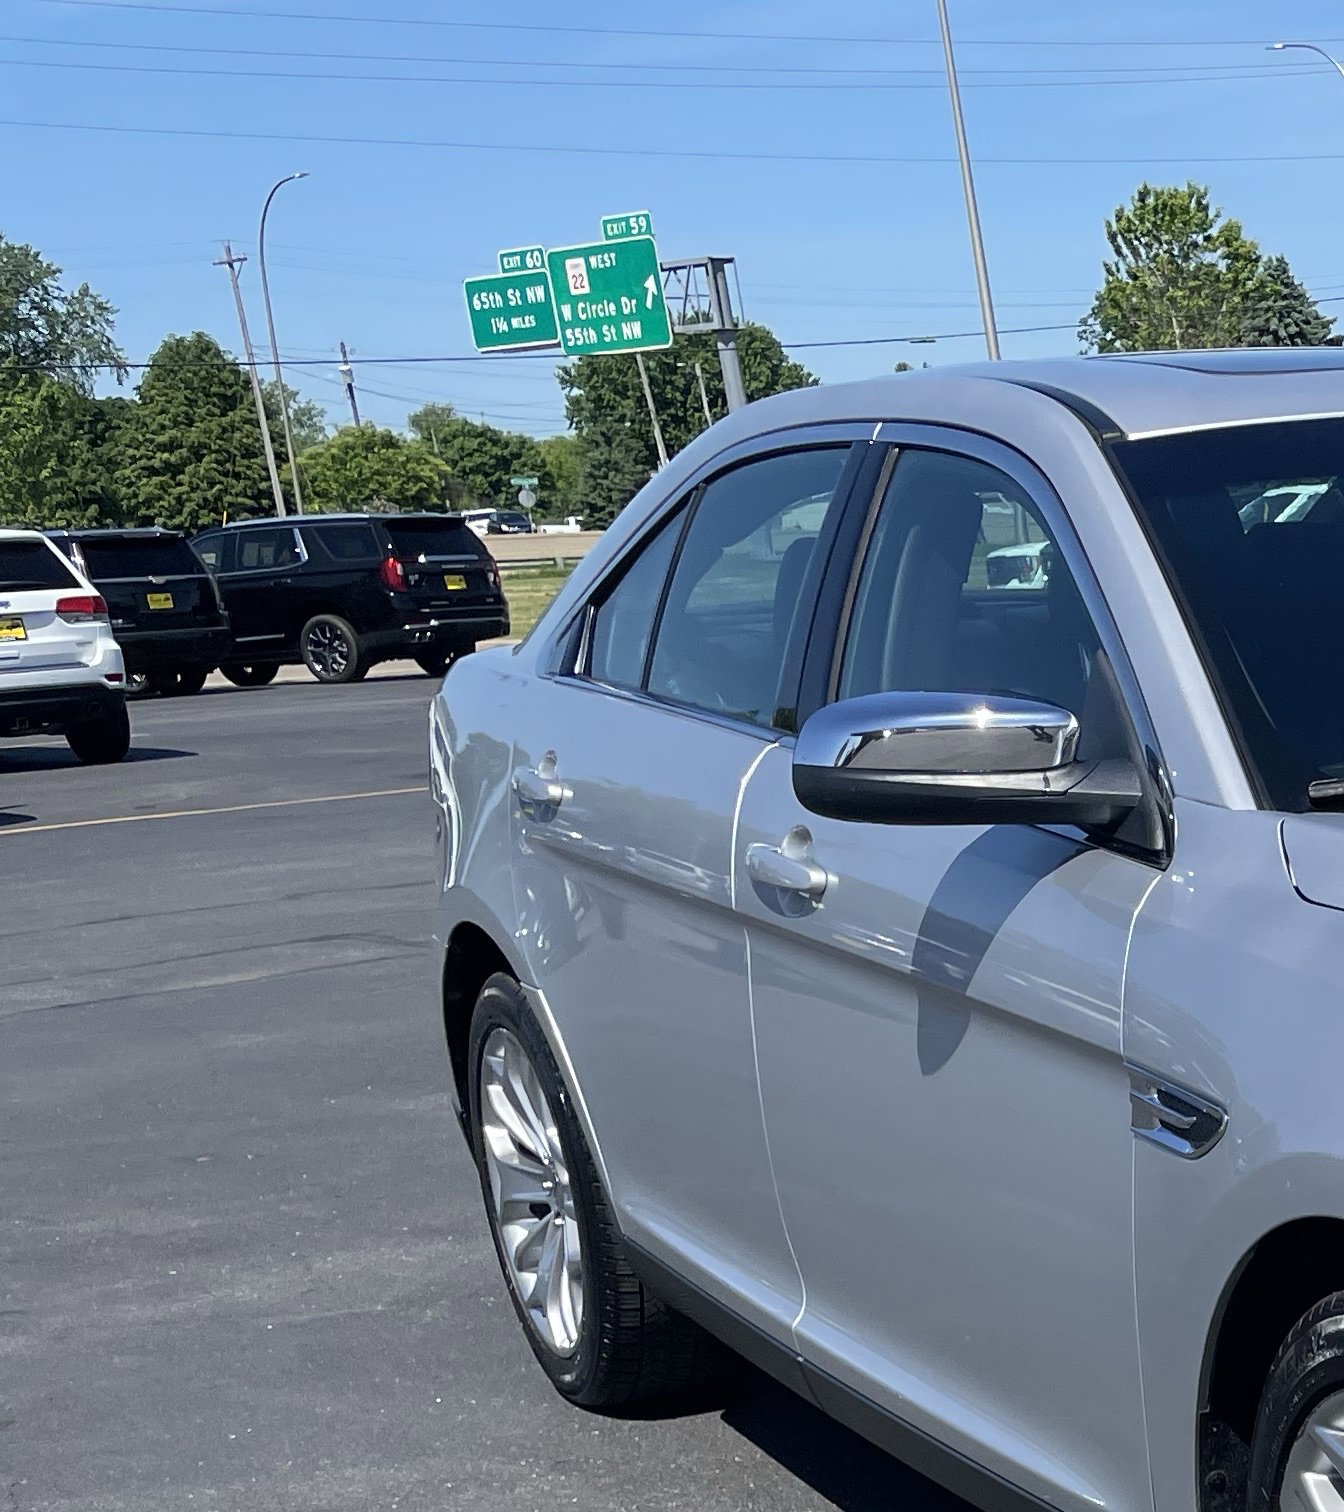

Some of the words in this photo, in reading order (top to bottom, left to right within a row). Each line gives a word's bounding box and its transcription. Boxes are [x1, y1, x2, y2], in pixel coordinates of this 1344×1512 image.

[606, 221, 626, 236] EXIT
[629, 216, 647, 234] 59
[502, 255, 521, 269] EXIT
[525, 250, 542, 268] 60
[589, 252, 616, 269] WEST
[571, 273, 586, 289] 22
[472, 291, 503, 311] 65th
[507, 288, 522, 306] St
[525, 284, 545, 304] NW
[560, 303, 572, 322] W
[577, 299, 617, 320] Circle
[620, 296, 637, 315] Dr
[511, 315, 536, 329] MILES
[565, 326, 598, 347] 55th
[602, 324, 618, 342] St
[621, 320, 642, 340] NW
